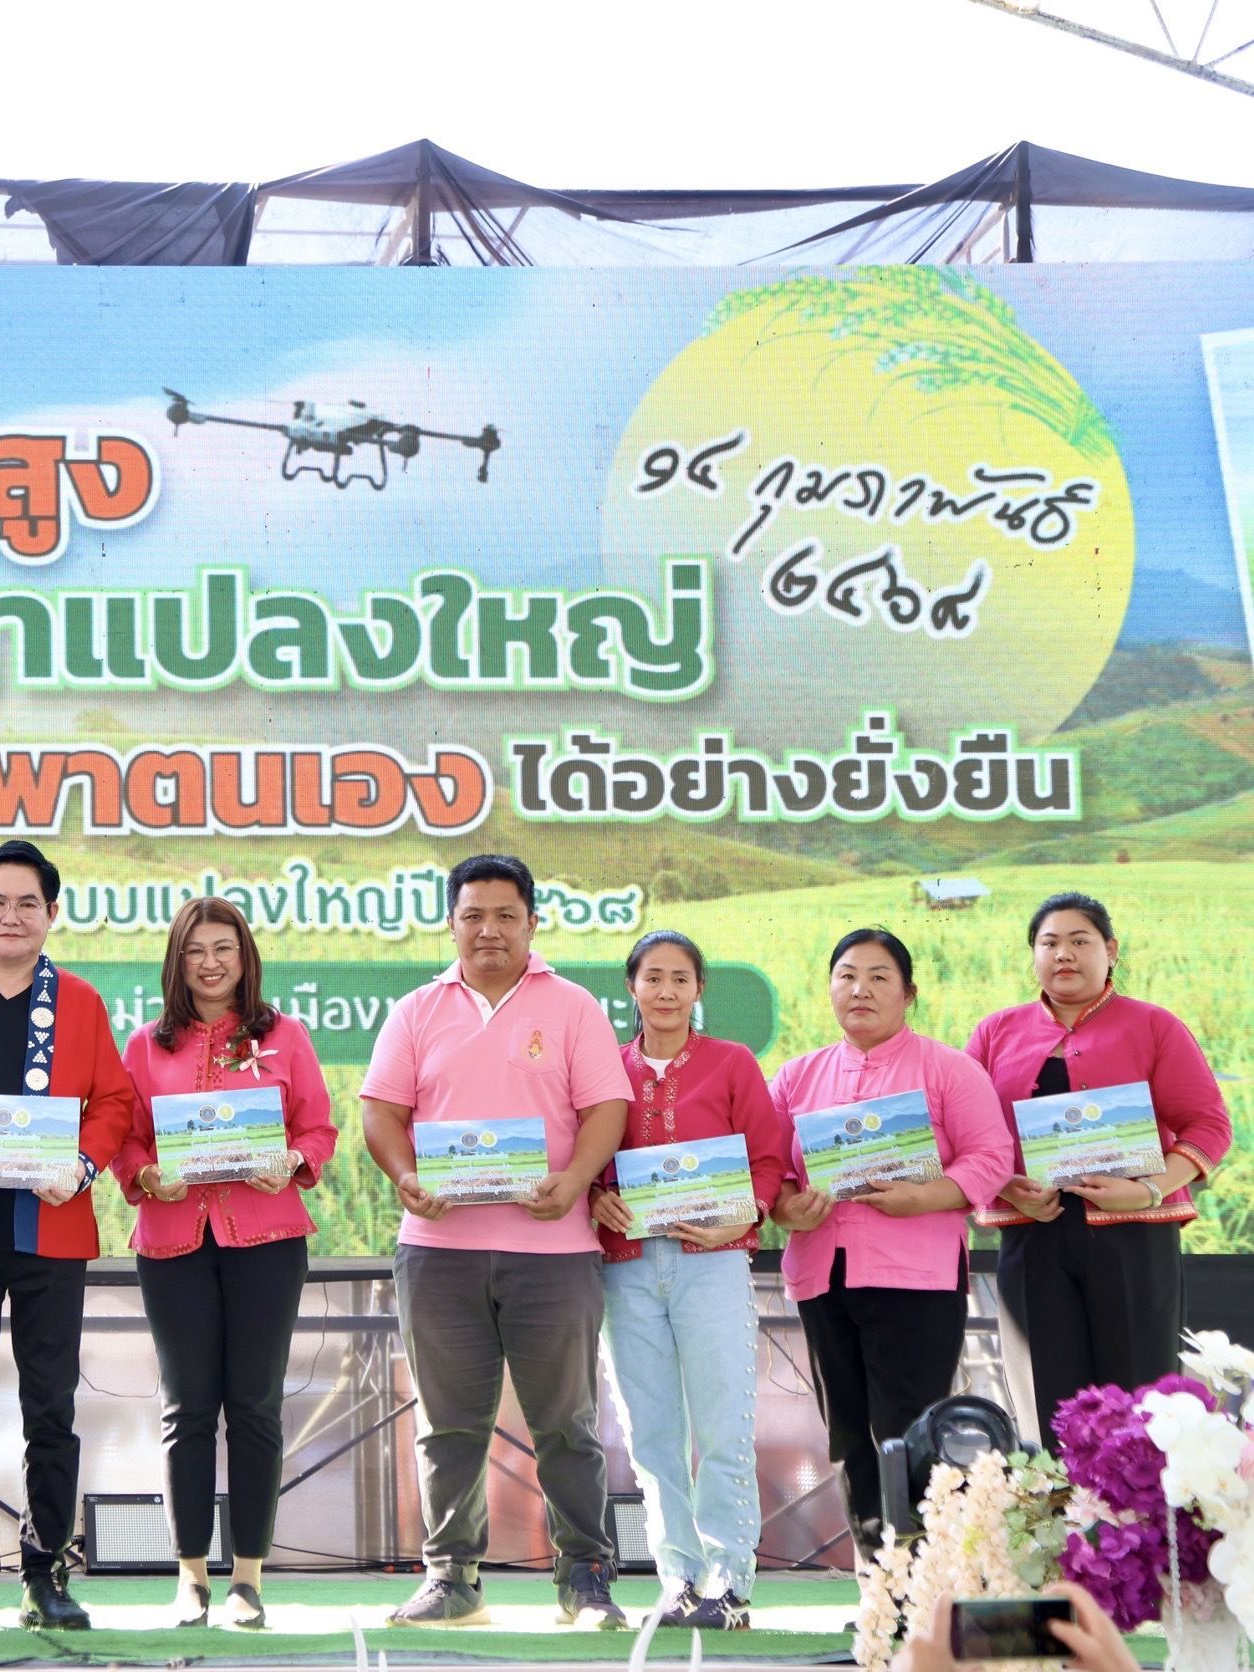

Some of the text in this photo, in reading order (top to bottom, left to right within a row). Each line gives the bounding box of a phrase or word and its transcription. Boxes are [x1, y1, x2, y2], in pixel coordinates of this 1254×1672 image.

[732, 462, 1095, 555] กุมภาพันธ์
[510, 713, 1075, 814] ได้อย่างยั่งยืน
